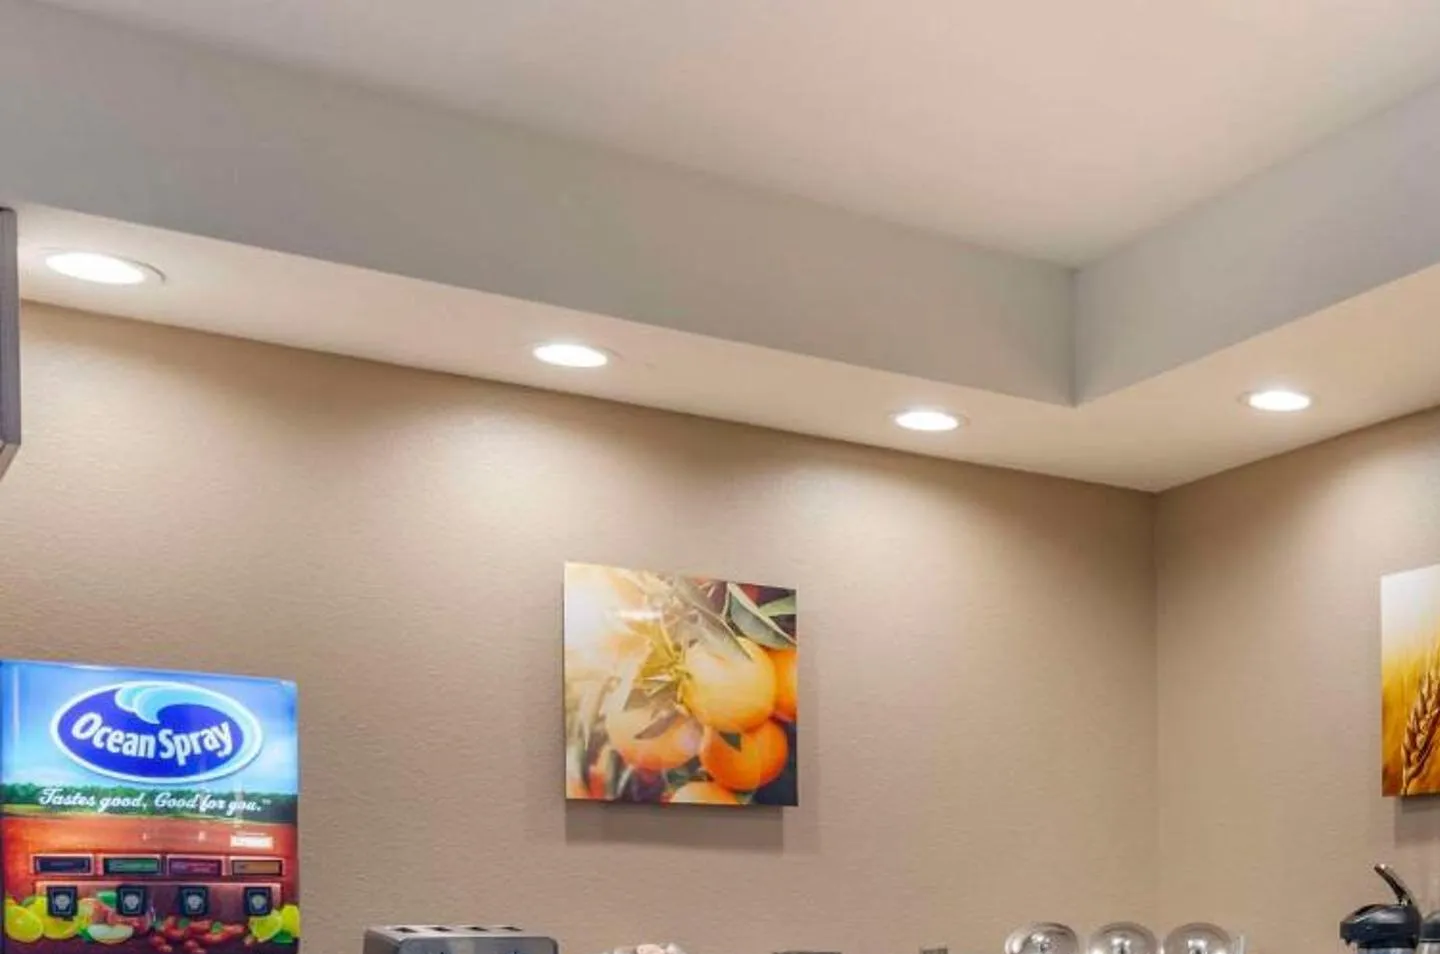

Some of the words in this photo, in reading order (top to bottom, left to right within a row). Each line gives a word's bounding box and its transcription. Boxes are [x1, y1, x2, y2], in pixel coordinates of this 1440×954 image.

[71, 712, 156, 759] Ocean
[158, 721, 233, 766] Spray
[39, 788, 96, 807] Tastes
[154, 792, 199, 808] Good
[198, 794, 226, 813] for
